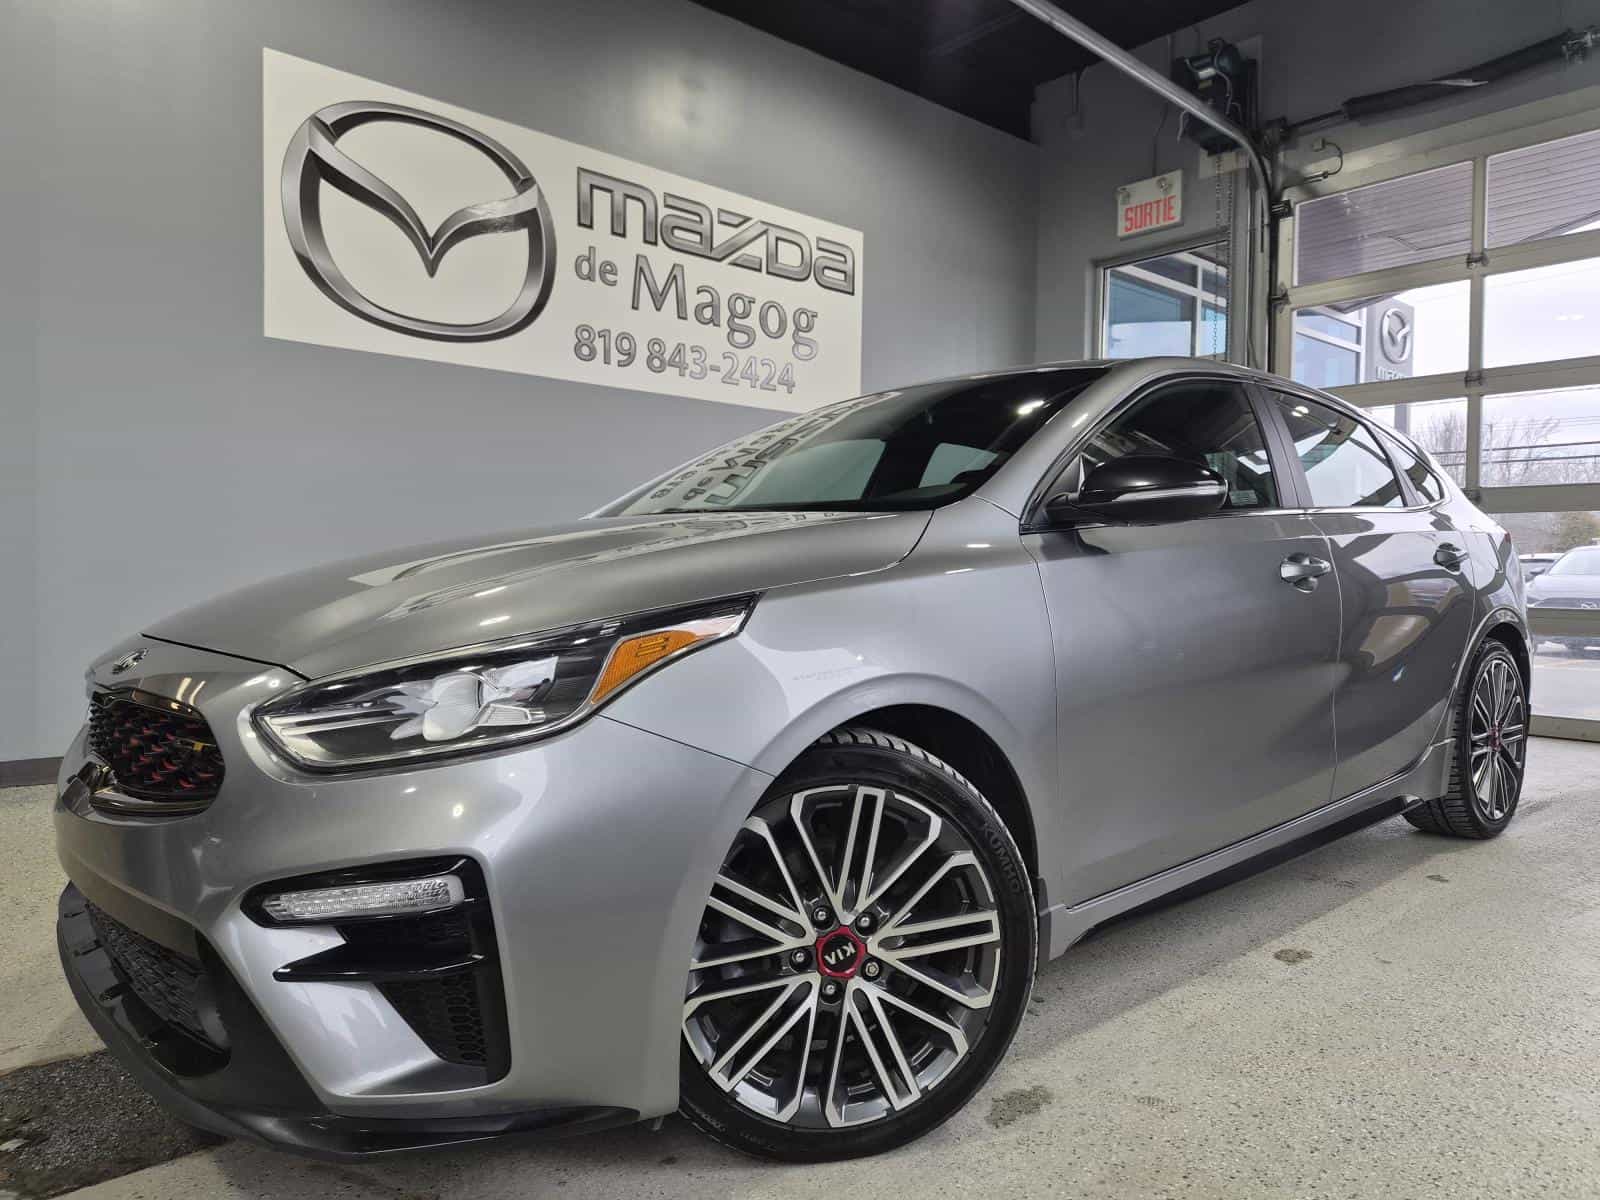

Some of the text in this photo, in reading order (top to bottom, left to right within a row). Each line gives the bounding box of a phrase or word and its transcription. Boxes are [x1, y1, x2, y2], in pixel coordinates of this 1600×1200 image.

[1124, 194, 1177, 232] SORTIE
[574, 246, 818, 361] de Magog
[574, 324, 796, 393] 819 843-2424
[824, 942, 856, 965] KIA
